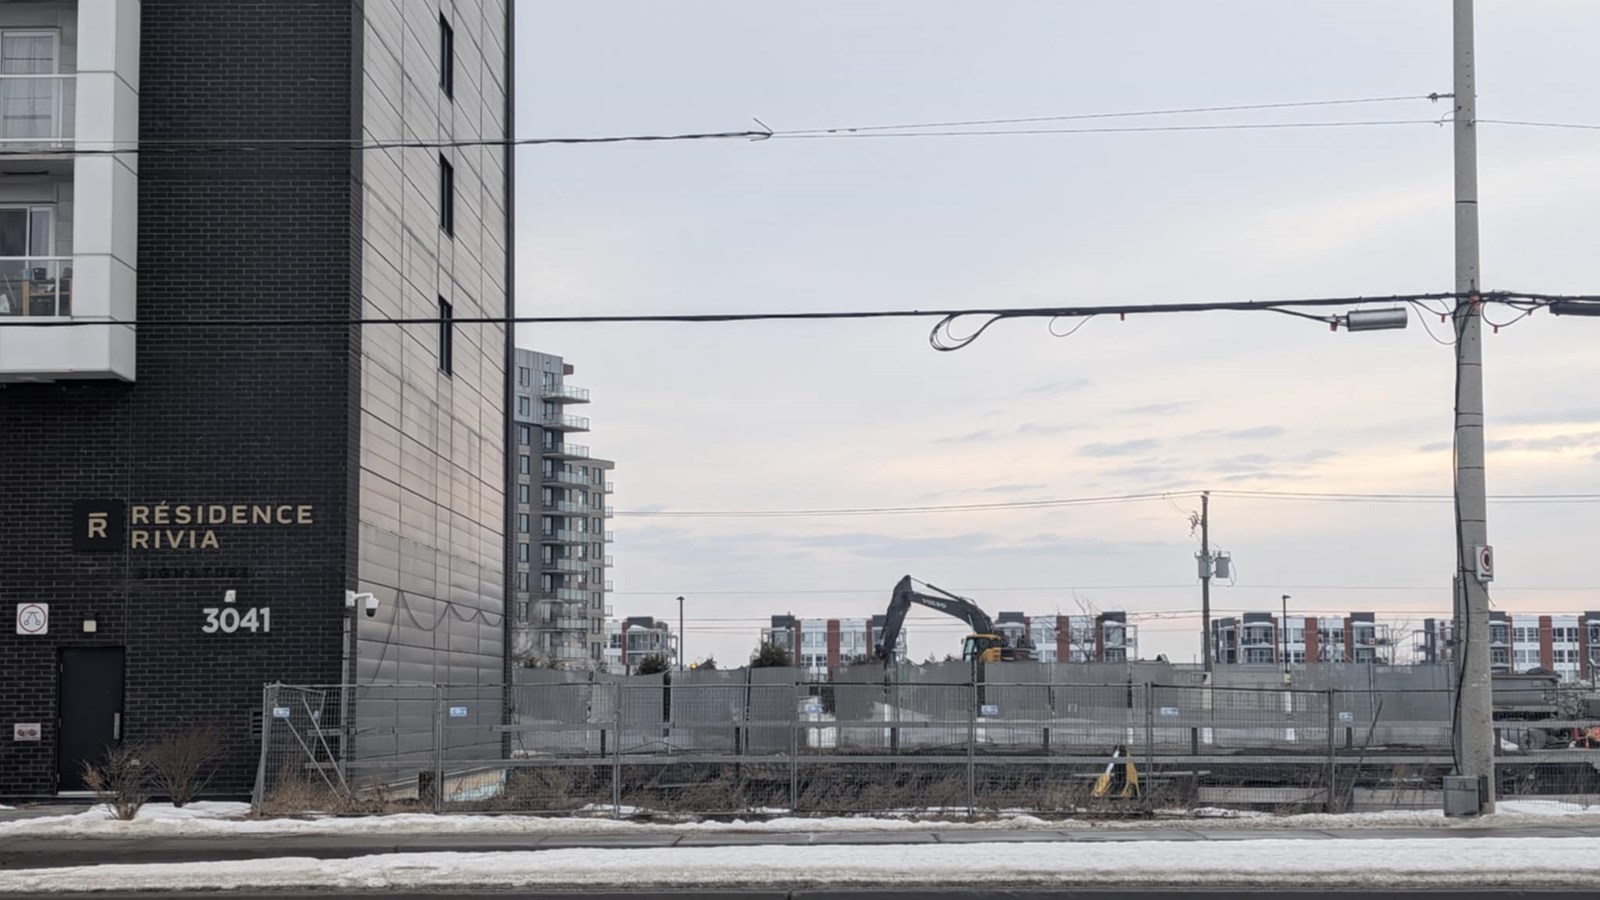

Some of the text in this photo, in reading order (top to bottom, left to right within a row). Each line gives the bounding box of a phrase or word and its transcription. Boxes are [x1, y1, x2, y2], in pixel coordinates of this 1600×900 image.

[131, 500, 314, 524] RÉSIDENCE
[131, 530, 220, 549] RIVIA
[921, 598, 948, 609] VOLVO
[202, 607, 271, 633] 3041
